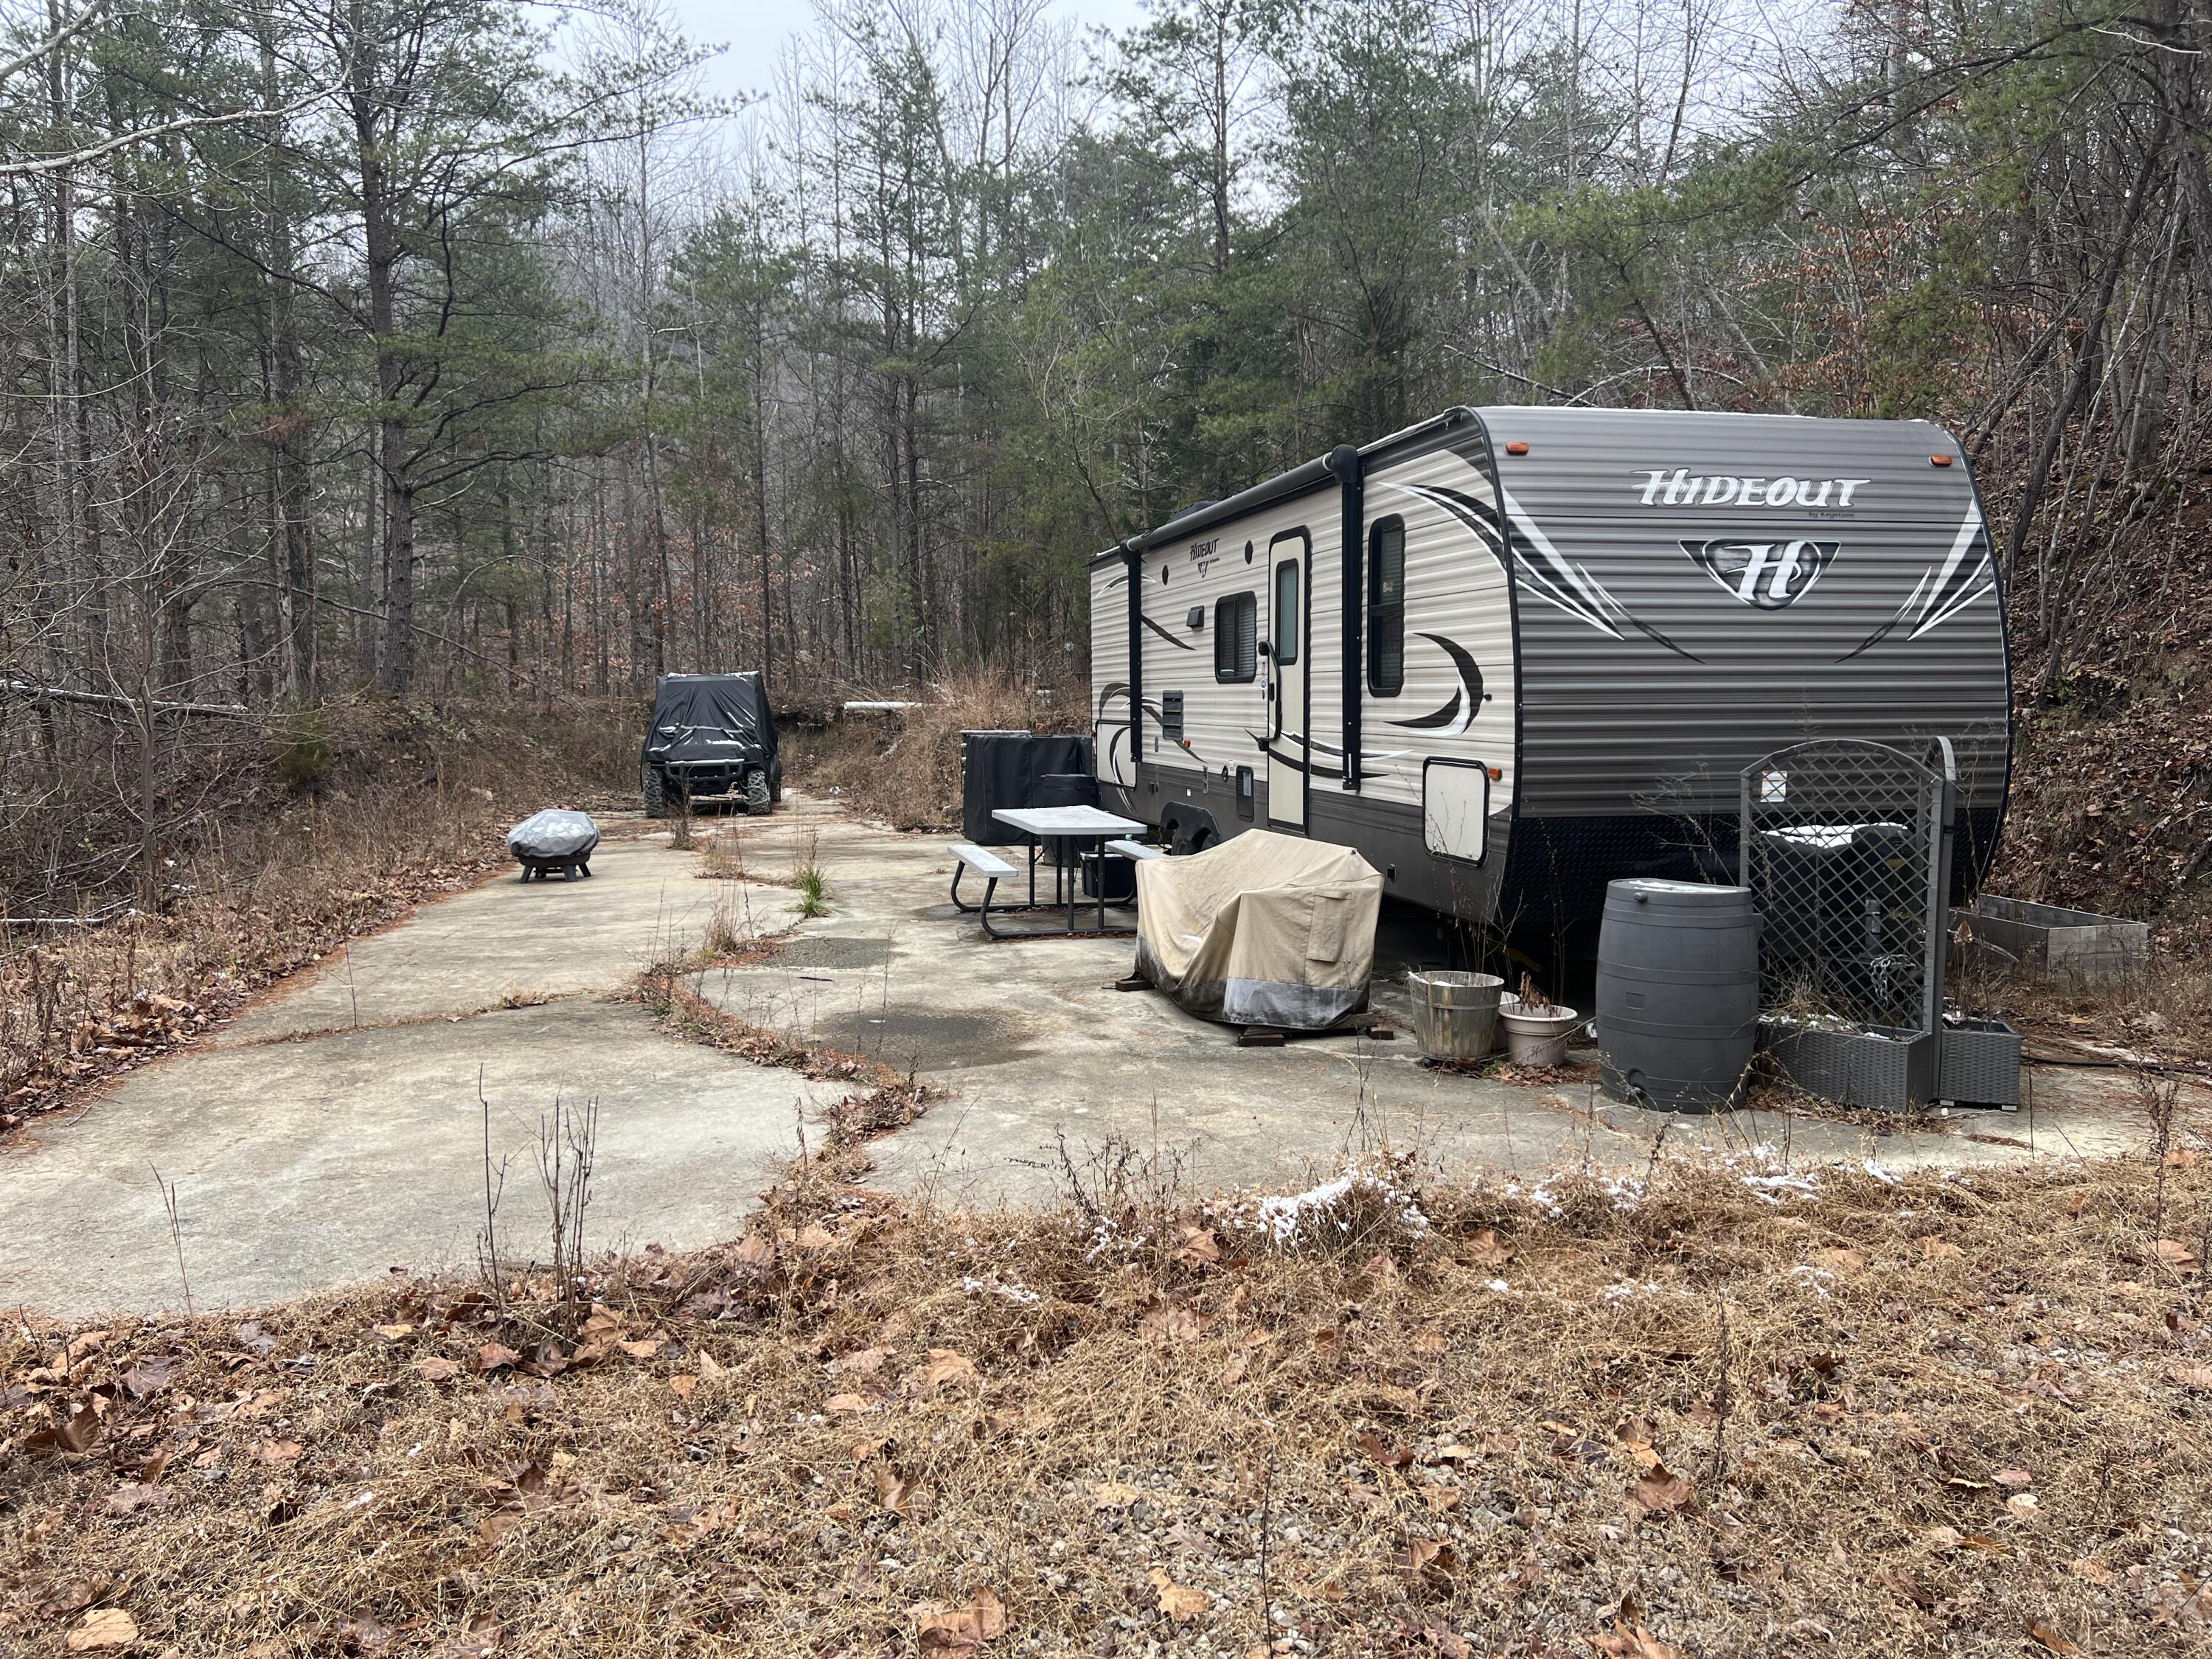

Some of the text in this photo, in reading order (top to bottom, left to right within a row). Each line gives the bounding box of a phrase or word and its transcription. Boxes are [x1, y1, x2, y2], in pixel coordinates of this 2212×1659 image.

[1631, 467, 1871, 507] HIDEOUT
[1190, 538, 1220, 562] HIDEOUT
[1722, 540, 1806, 602] H
